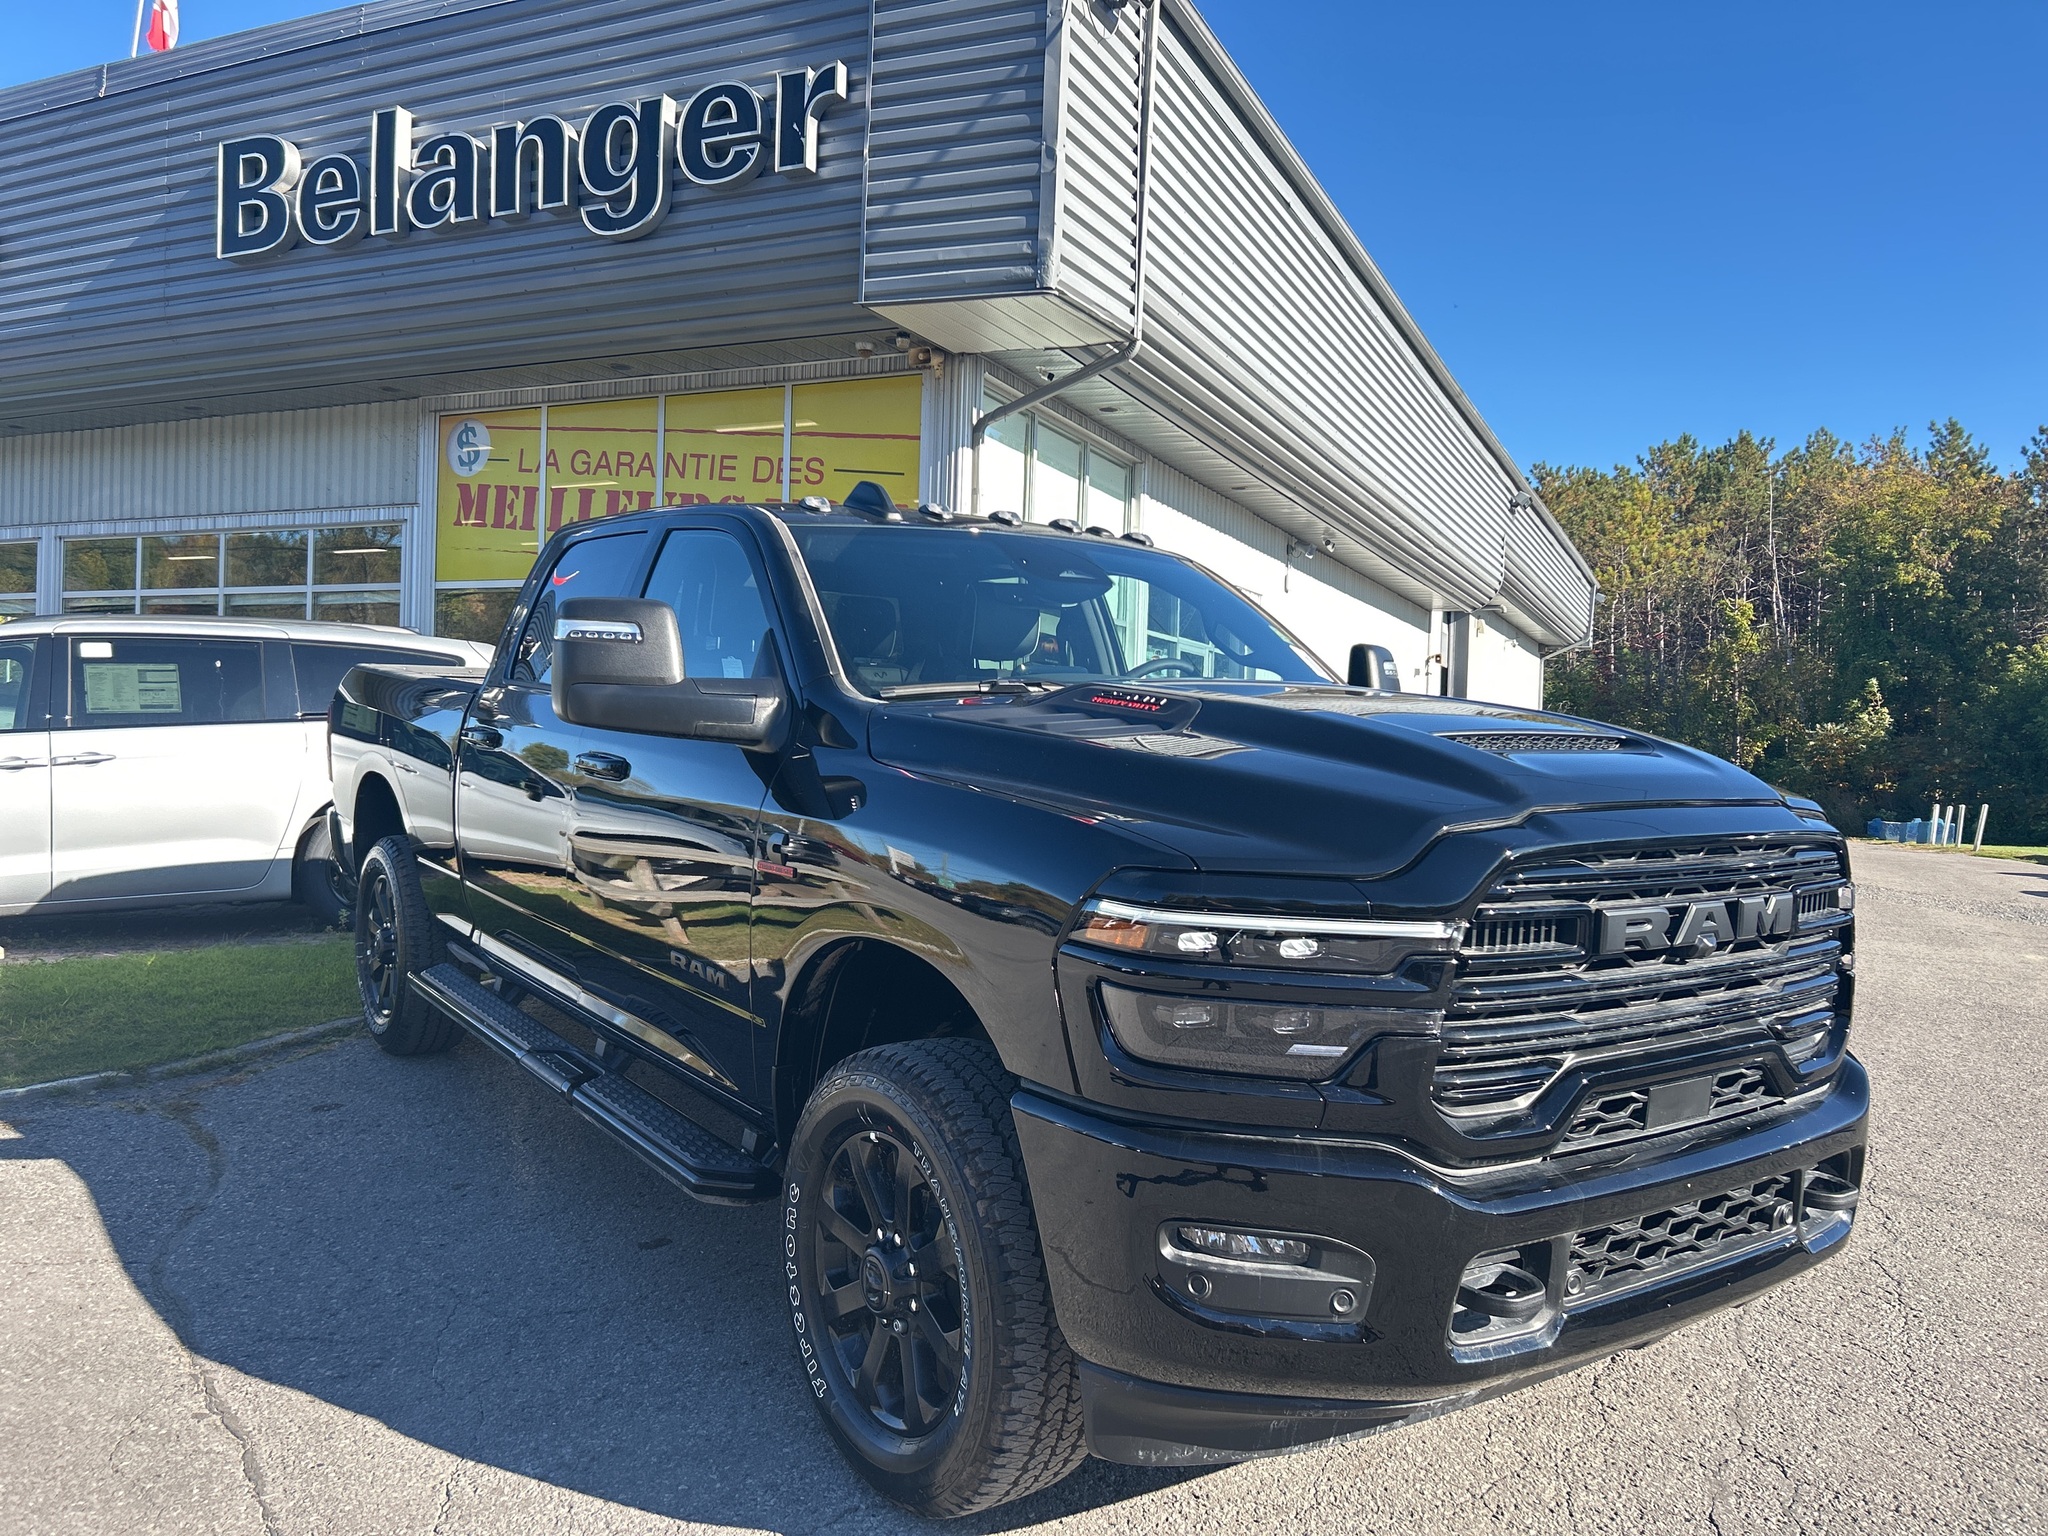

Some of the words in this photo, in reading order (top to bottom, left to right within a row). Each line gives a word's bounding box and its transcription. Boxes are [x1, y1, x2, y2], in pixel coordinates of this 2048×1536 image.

[216, 59, 848, 262] Belanger
[456, 422, 480, 472] $
[518, 448, 561, 474] LA
[570, 449, 738, 482] GARANTIE
[752, 456, 825, 485] DES
[453, 483, 745, 532] MEILLE
[1600, 892, 1794, 955] RAM
[669, 950, 728, 989] RAM
